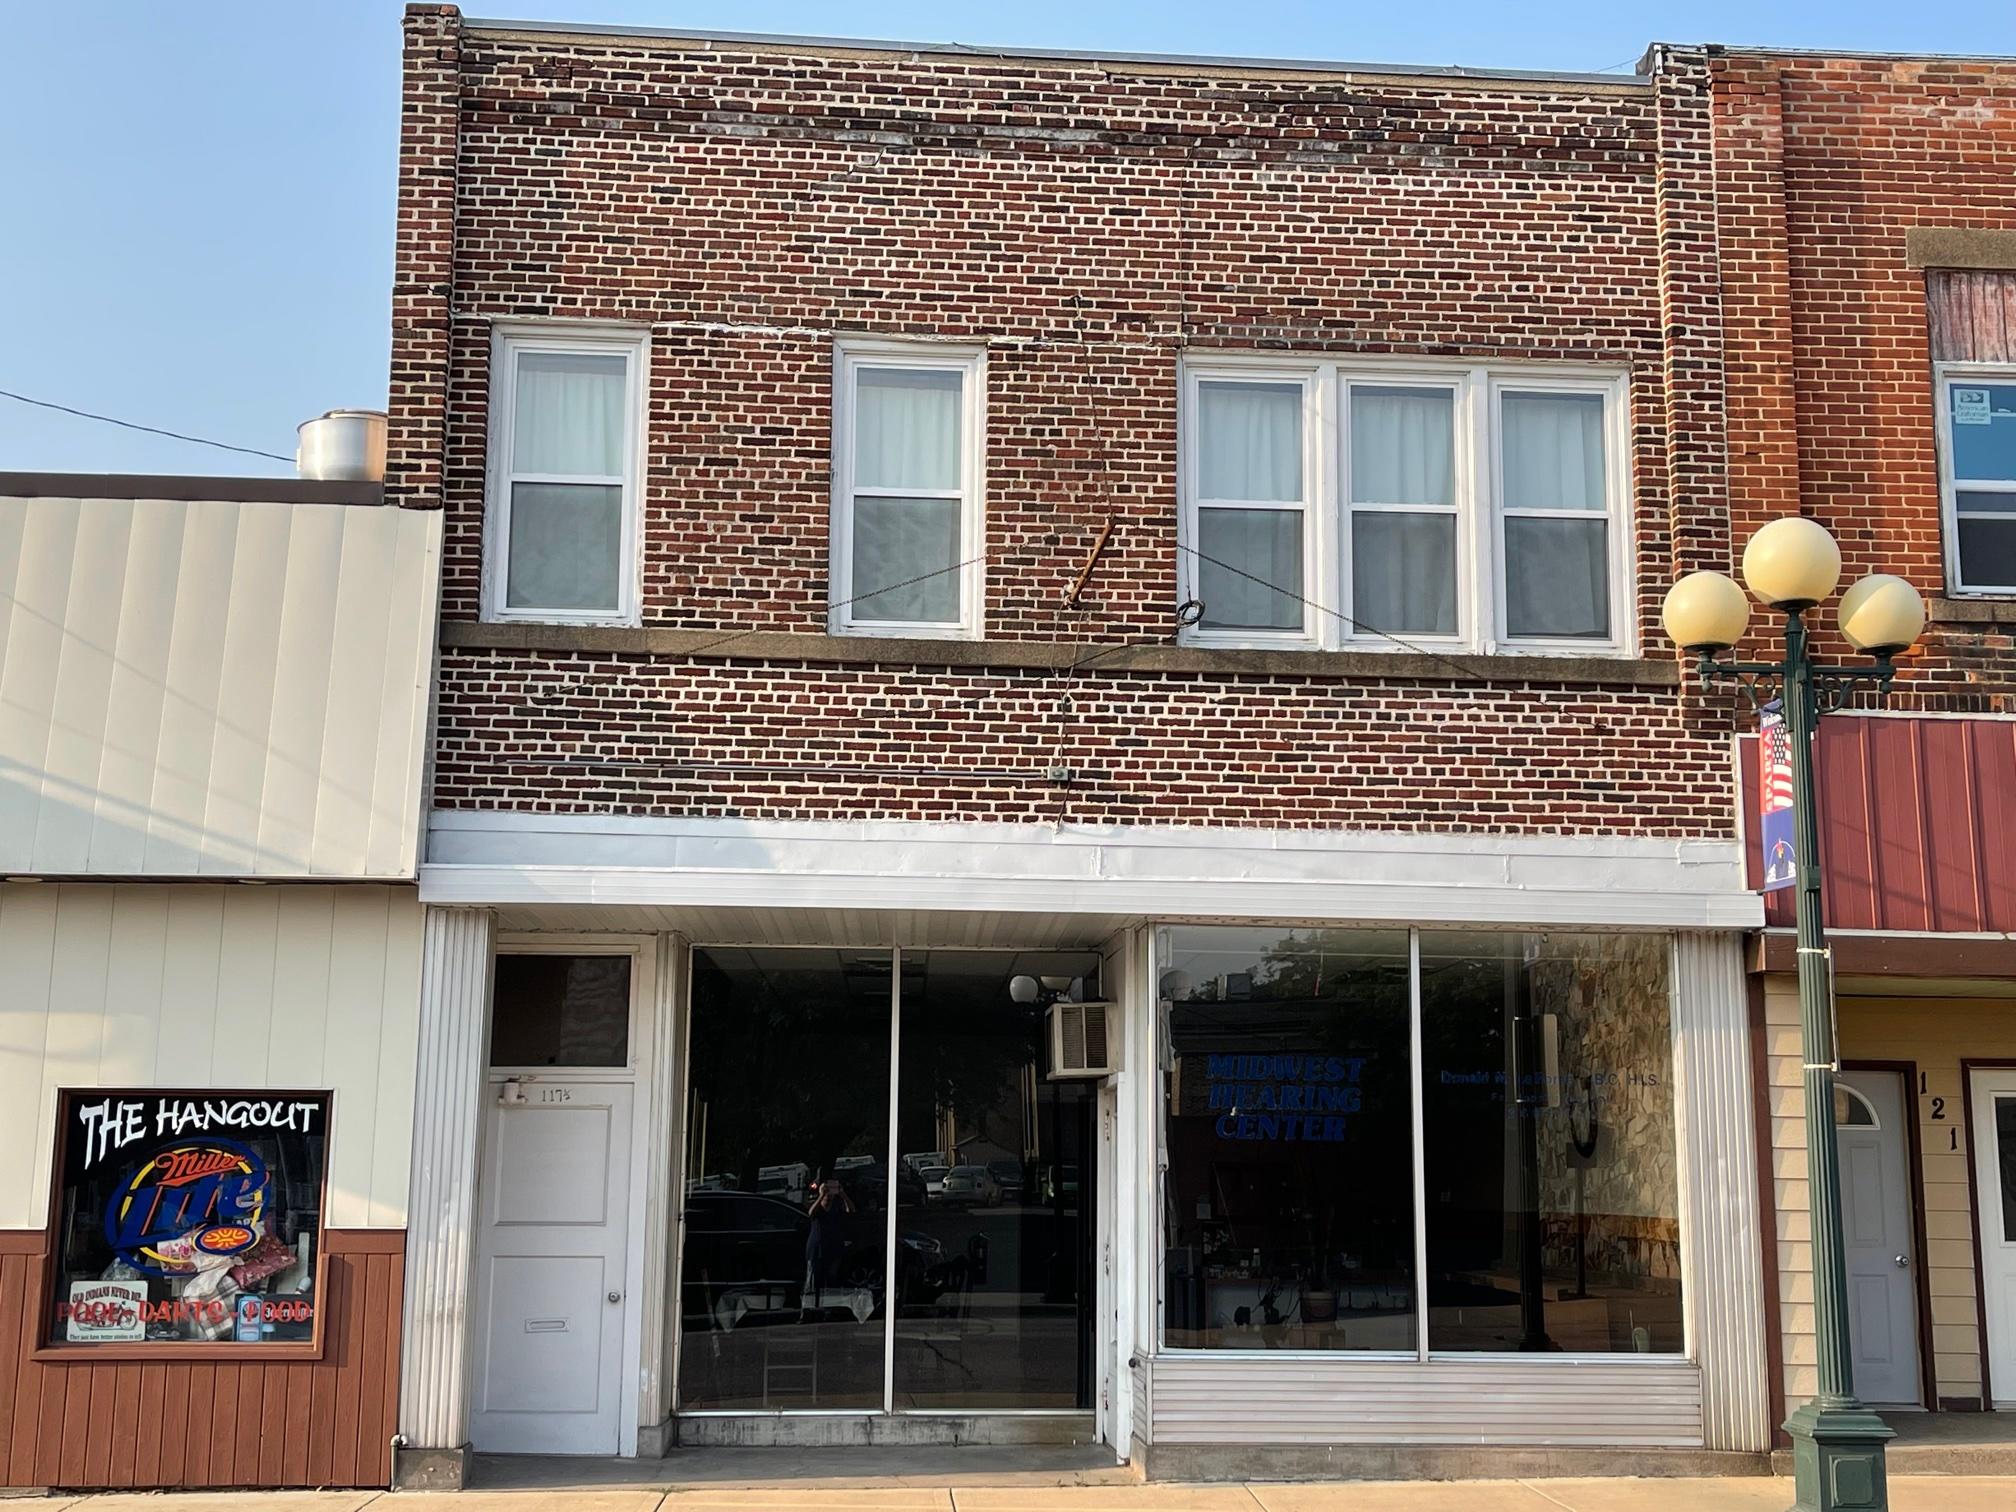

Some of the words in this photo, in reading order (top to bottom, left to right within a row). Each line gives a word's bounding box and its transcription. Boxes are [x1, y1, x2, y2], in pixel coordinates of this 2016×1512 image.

[1763, 734, 1774, 812] SPARTA
[1205, 1055, 1367, 1082] MIDWEST
[1208, 1083, 1361, 1112] HEARING
[80, 1099, 147, 1170] THE
[156, 1099, 319, 1136] HANGOUT
[1215, 1113, 1346, 1142] CENTER
[155, 1152, 248, 1184] Miller
[139, 1300, 223, 1323] DARTS
[244, 1299, 311, 1323] FOOD
